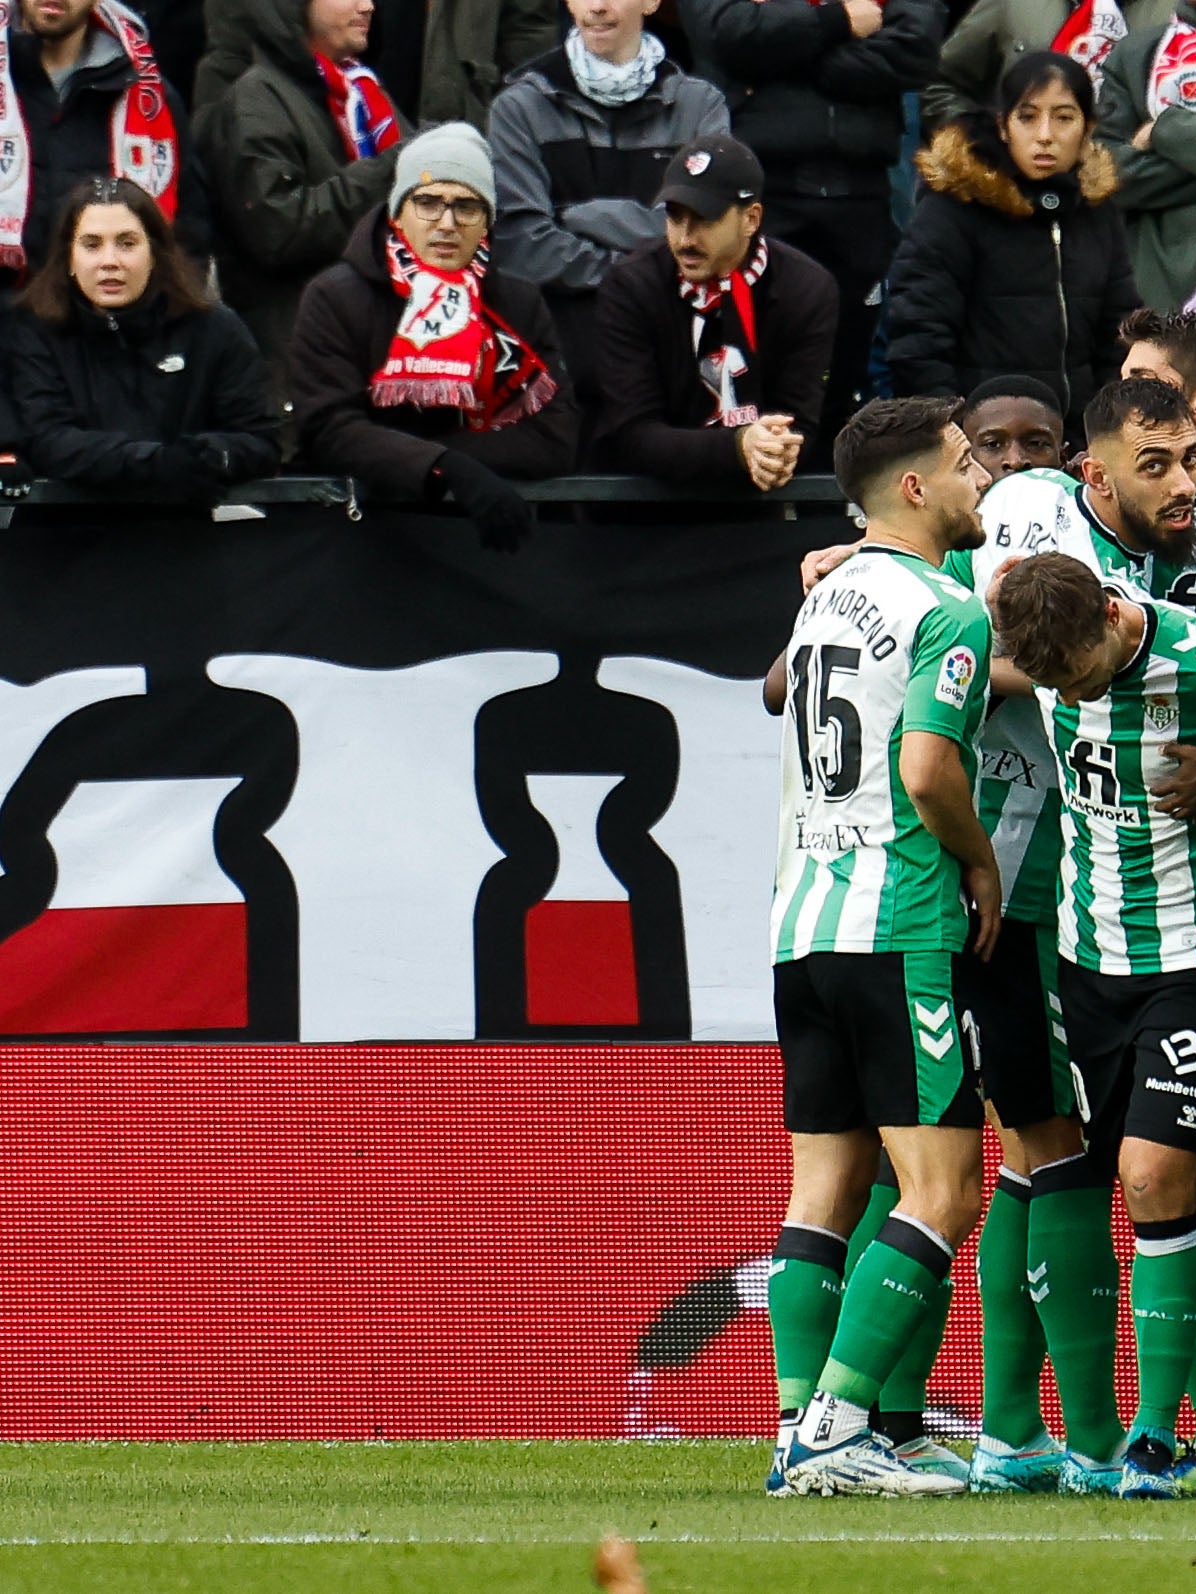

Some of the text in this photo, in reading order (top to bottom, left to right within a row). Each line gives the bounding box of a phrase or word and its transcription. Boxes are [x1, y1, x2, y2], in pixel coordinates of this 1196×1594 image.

[821, 588, 897, 661] MORENO
[789, 644, 863, 803] 15
[1070, 795, 1136, 824] network
